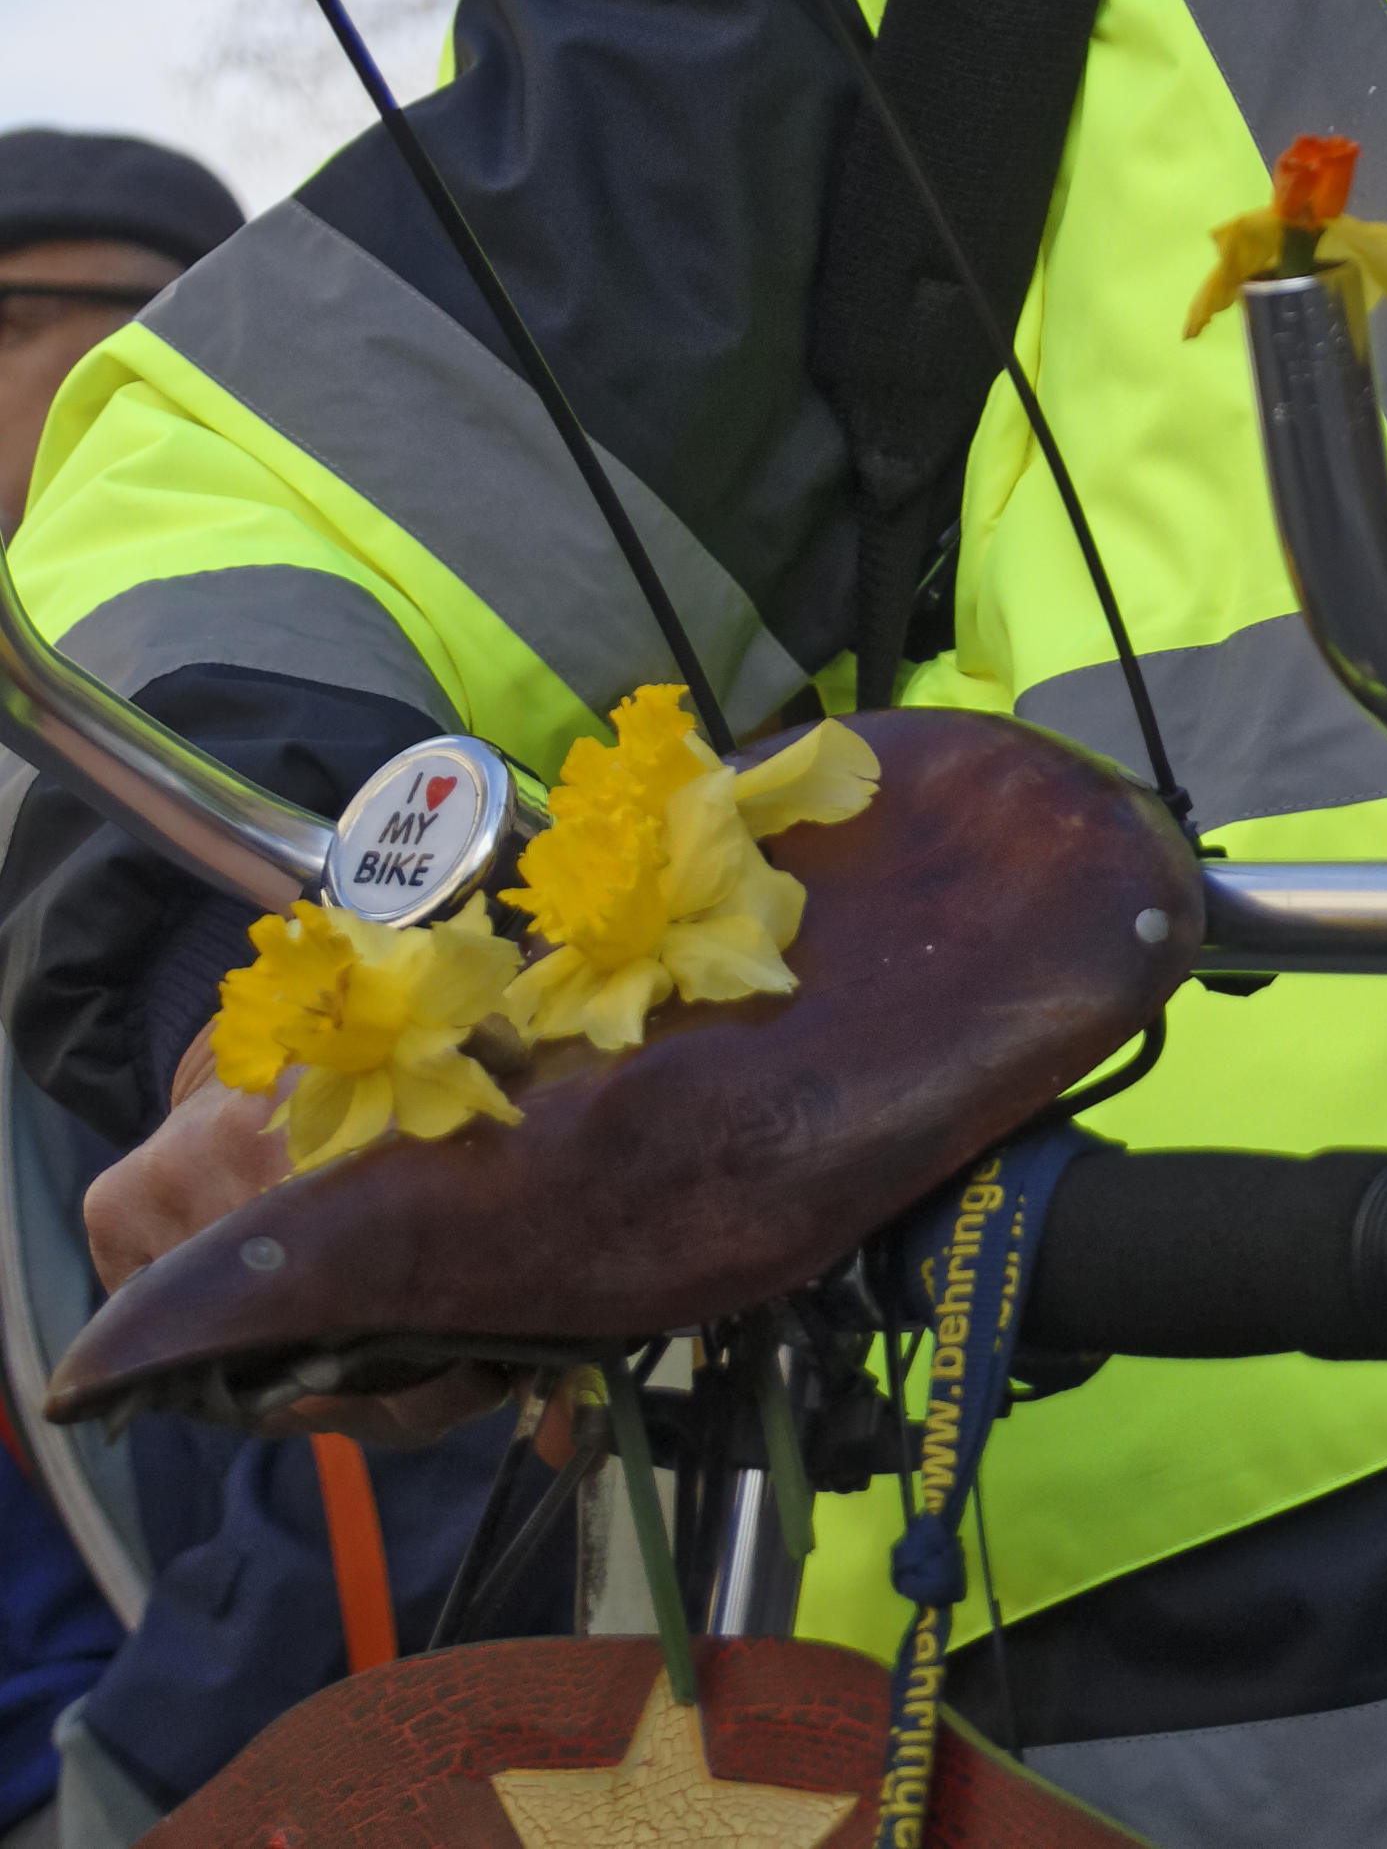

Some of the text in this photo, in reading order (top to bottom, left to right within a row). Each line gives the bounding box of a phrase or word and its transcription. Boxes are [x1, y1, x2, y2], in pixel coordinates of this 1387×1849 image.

[406, 771, 424, 804] I
[378, 810, 439, 845] MY
[353, 850, 434, 887] BIKE
